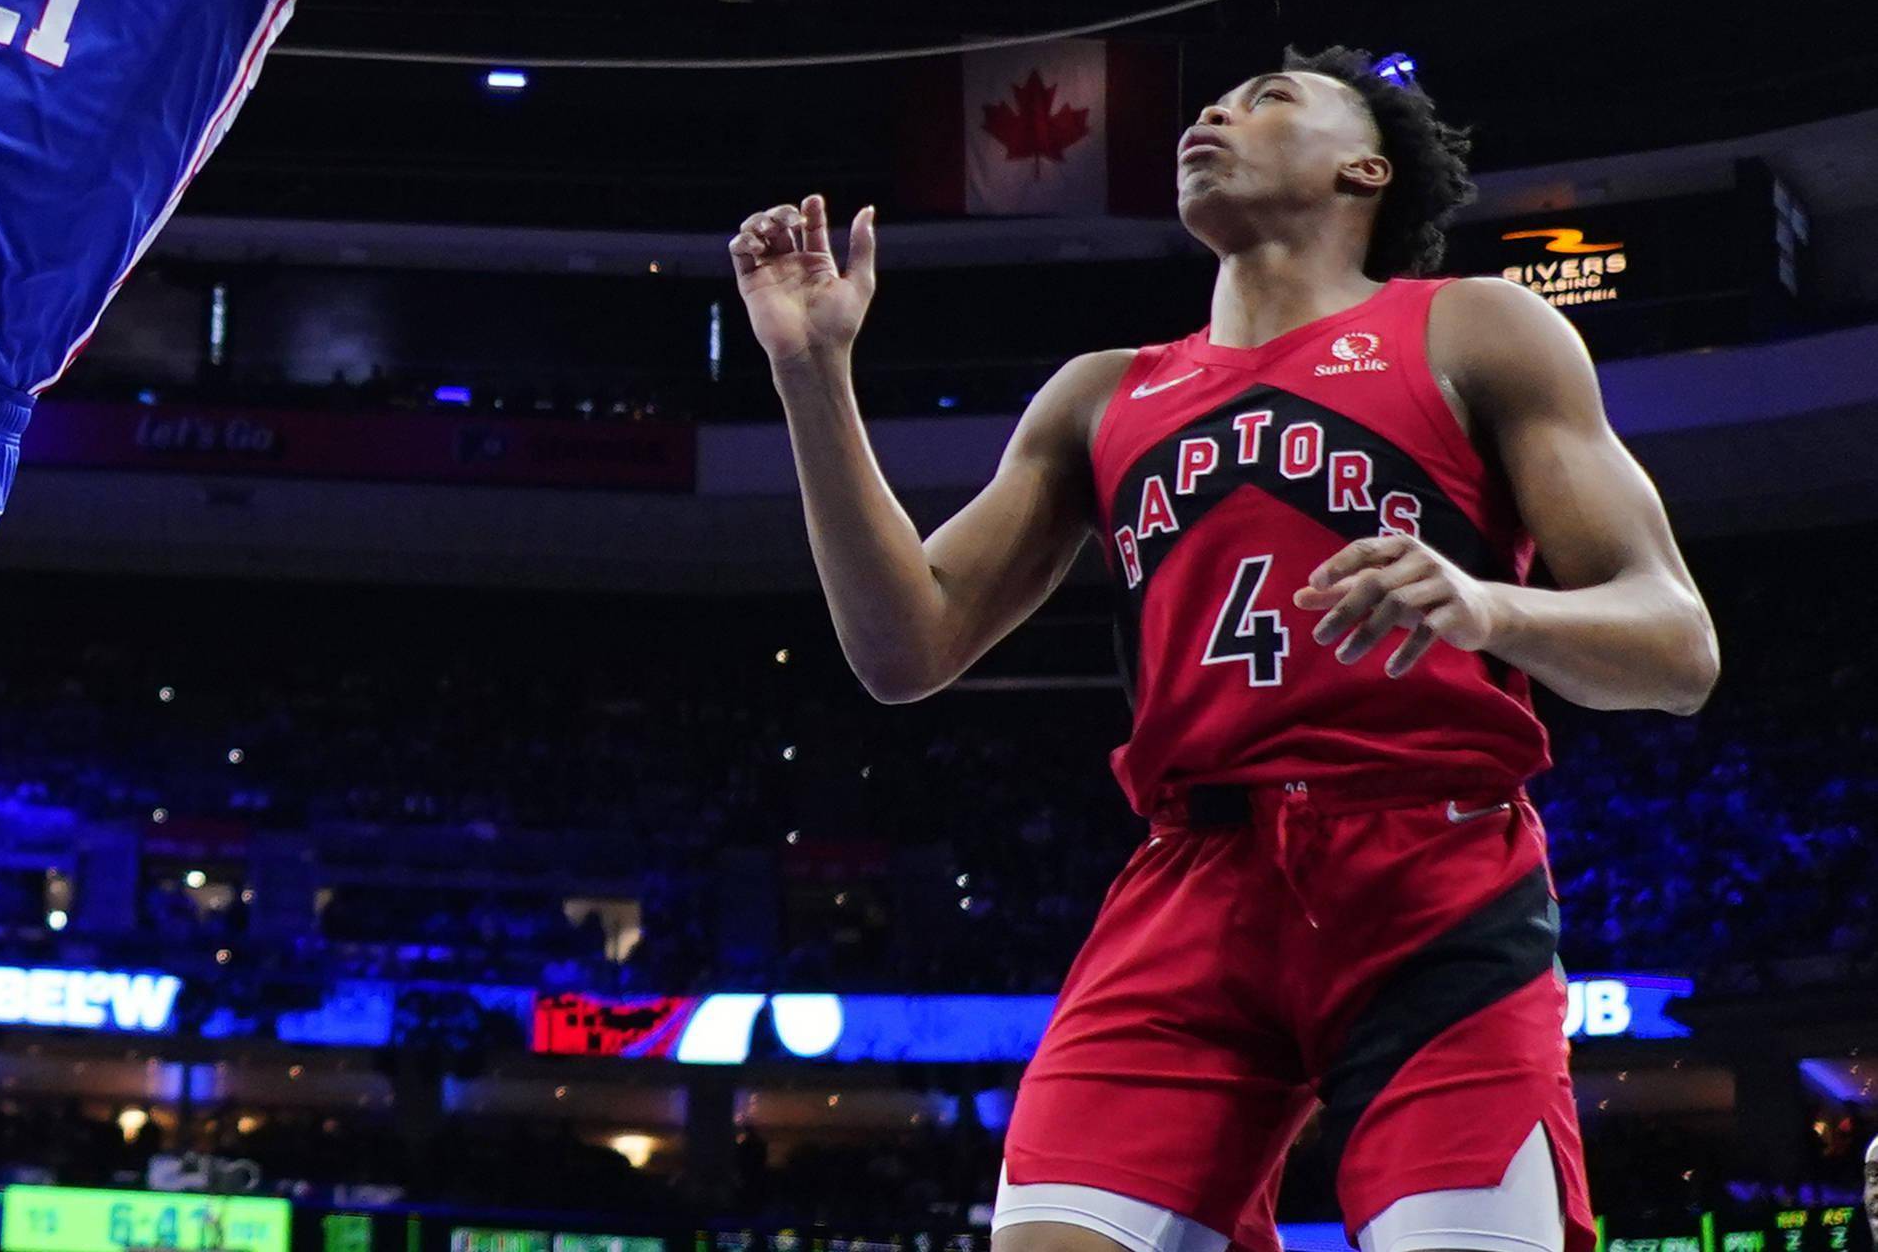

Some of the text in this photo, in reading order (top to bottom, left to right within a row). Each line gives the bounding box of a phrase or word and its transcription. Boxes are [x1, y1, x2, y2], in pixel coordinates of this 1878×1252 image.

[1502, 252, 1627, 284] RIVERS
[1314, 358, 1389, 377] Sun Life
[1113, 407, 1424, 590] RAPTORS
[1200, 553, 1291, 688] 4
